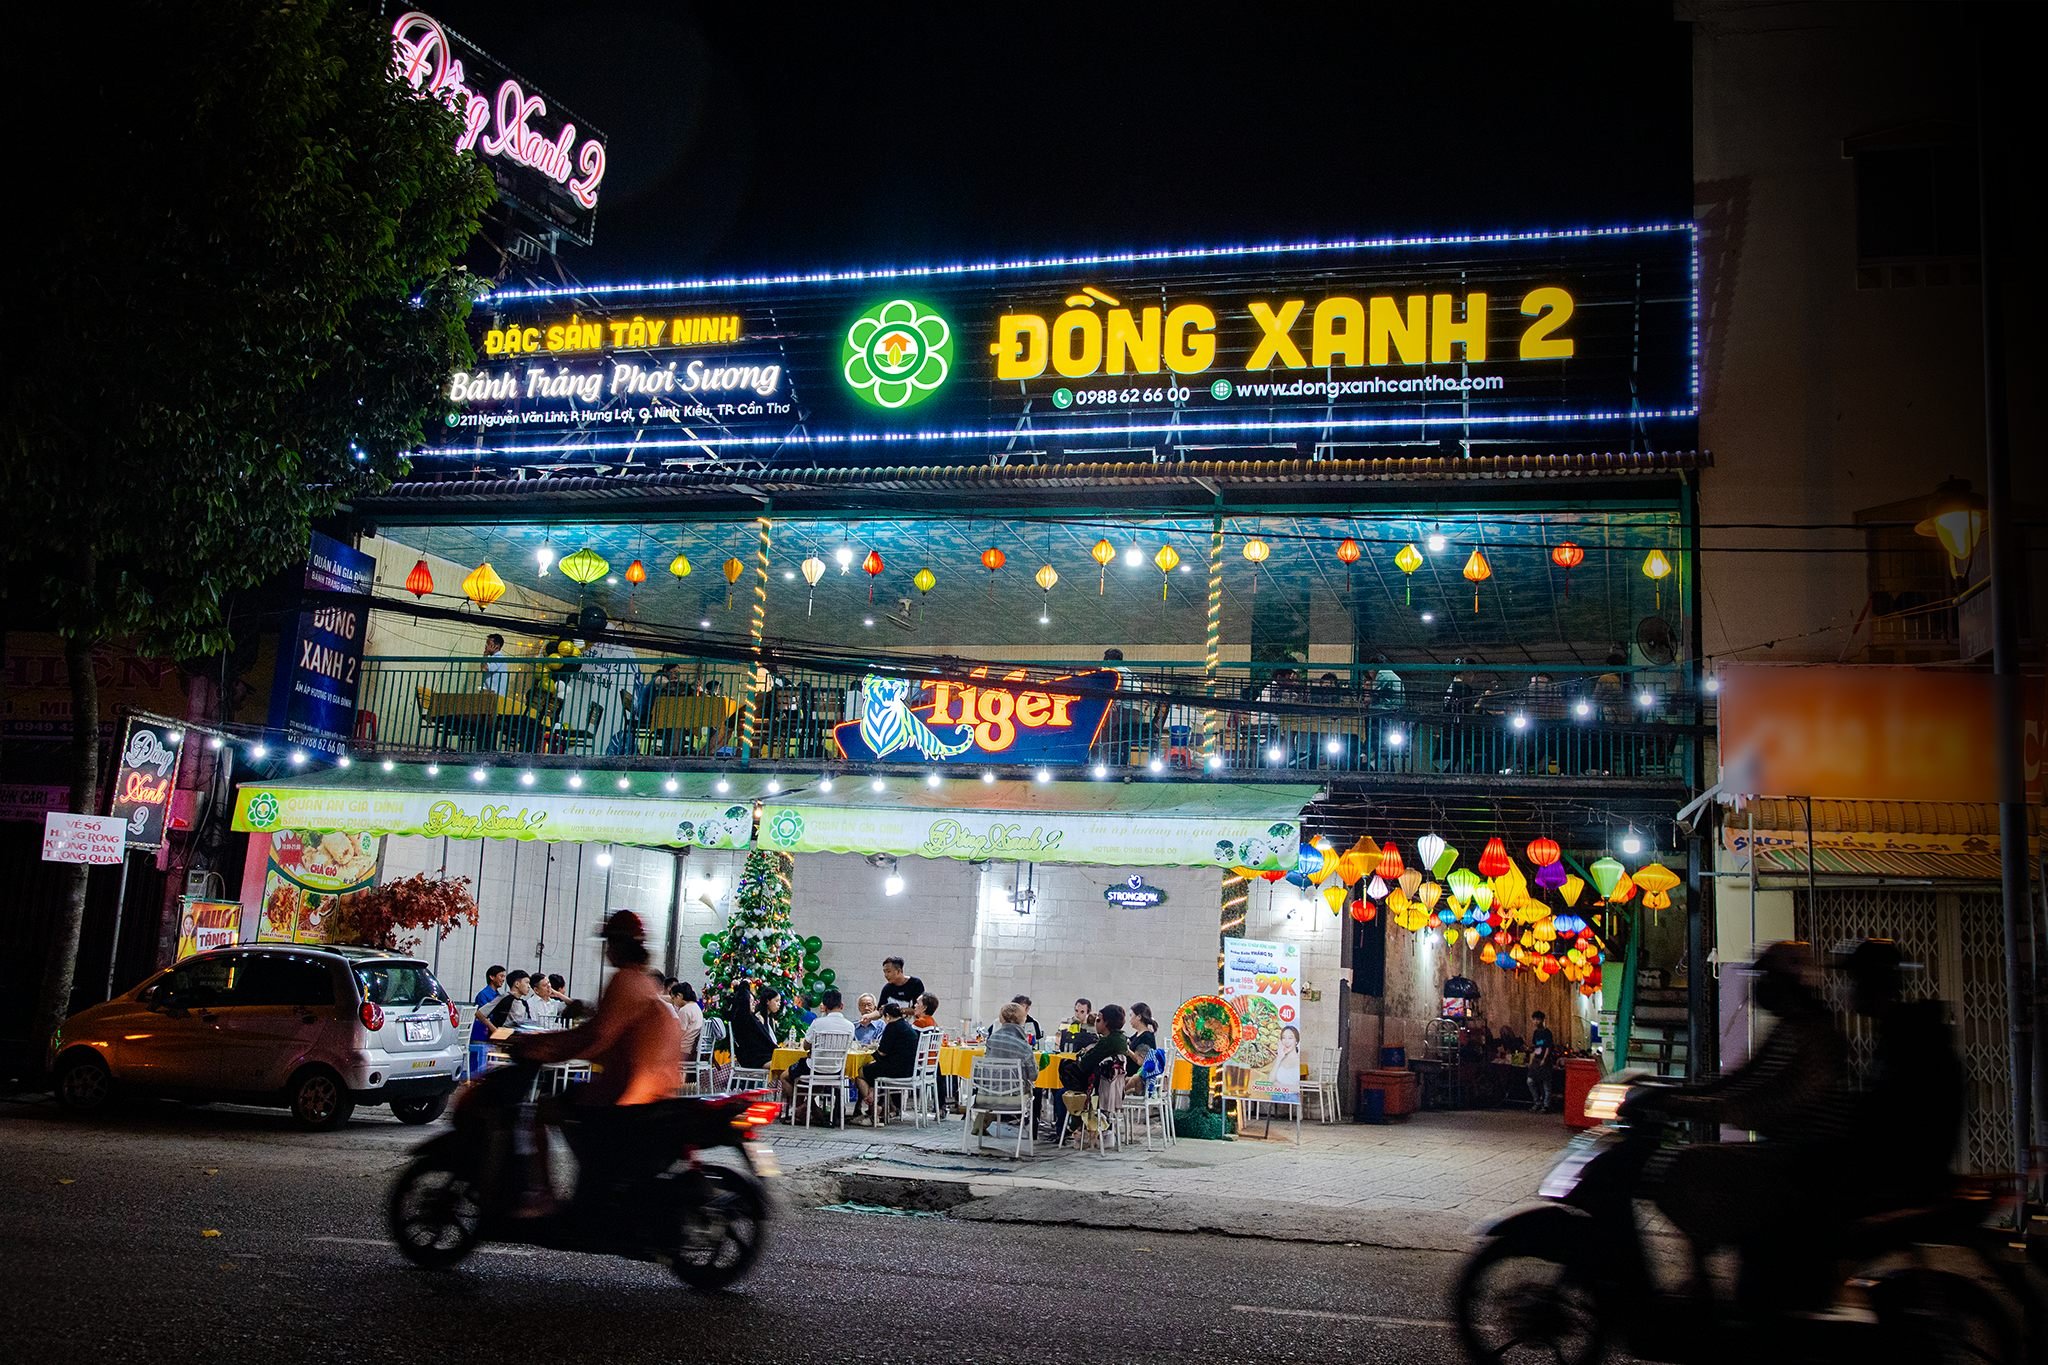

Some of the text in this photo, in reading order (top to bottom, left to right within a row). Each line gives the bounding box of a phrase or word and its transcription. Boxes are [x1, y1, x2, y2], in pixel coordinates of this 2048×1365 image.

[482, 80, 574, 184] Xanh
[569, 140, 605, 209] 2
[484, 314, 740, 359] ĐẶC SẢN TÂY NINH
[990, 286, 1575, 380] ĐỒNG XANH 2
[450, 360, 781, 402] Bánh Tráng Phơi Sương
[1236, 373, 1504, 400] www.dongxanhcantho.com
[1076, 386, 1190, 406] 0988 62 66 00
[460, 414, 477, 426] 211
[479, 410, 519, 427] Nguyễn
[521, 411, 544, 424] Văn
[582, 409, 613, 423] Hưng
[654, 406, 680, 419] Ninh
[737, 401, 763, 415] Cần
[766, 402, 791, 414] Thơ
[299, 638, 356, 684] XANH 2
[921, 666, 1081, 752] Tiger
[317, 738, 327, 751] 62
[327, 740, 336, 754] 66
[120, 772, 168, 804] Xanh
[128, 806, 149, 836] 2
[474, 805, 528, 832] Xanh
[525, 810, 548, 831] 2
[982, 823, 1043, 854] Xanh
[1042, 829, 1065, 851] 2
[1144, 847, 1154, 855] 62
[1167, 847, 1177, 855] 00
[1883, 838, 1921, 851] ÁO
[197, 908, 240, 928] MUA 1
[199, 930, 233, 949] TẶNG 1
[1255, 974, 1297, 997] 99K
